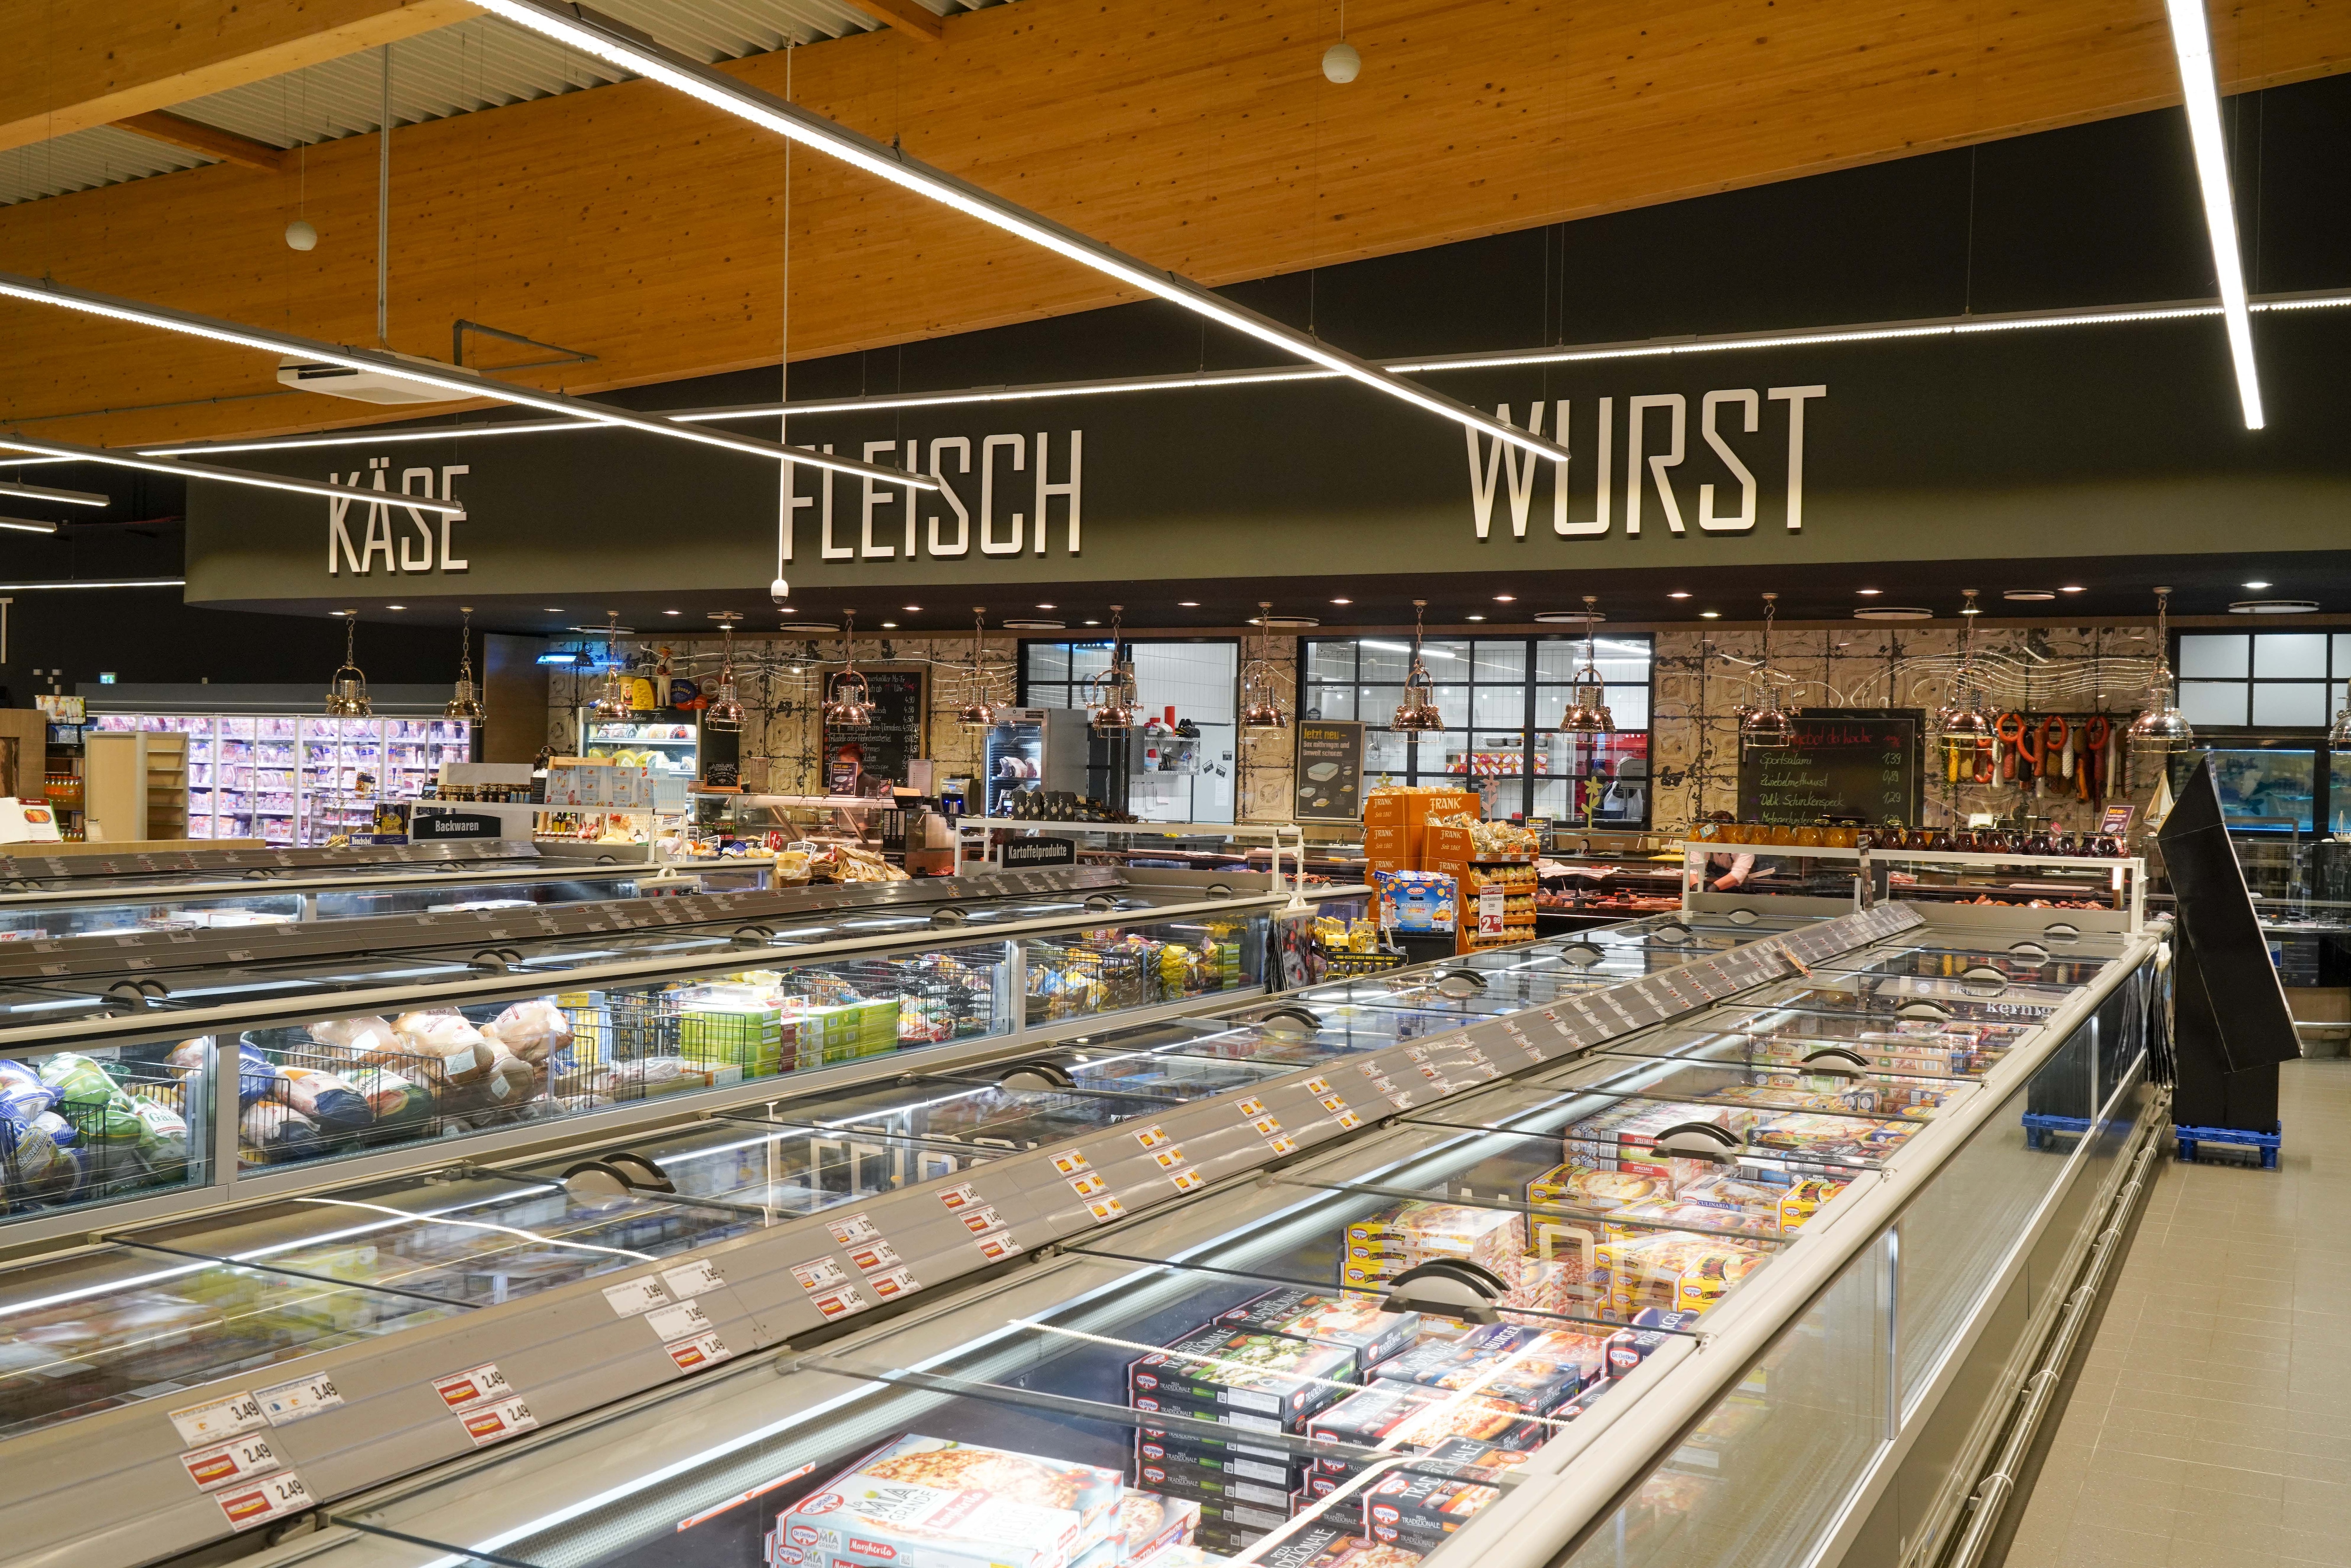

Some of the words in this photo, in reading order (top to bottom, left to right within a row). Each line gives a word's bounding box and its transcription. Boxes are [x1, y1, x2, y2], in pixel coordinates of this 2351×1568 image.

[1465, 385, 1826, 537] WURST
[783, 430, 1081, 559] FLEISCH
[329, 457, 469, 573] KÄSE
[1303, 728, 1322, 740] Jetzt
[1313, 741, 1339, 749] mitbringen
[1760, 752, 1812, 769] Sportsalami
[1373, 798, 1393, 808] FRANK
[1429, 796, 1462, 811] FRANK
[435, 820, 479, 832] Backwaren
[1374, 829, 1393, 839] FRANK
[1440, 830, 1462, 840] FRANK
[1009, 843, 1067, 861] Kartoffelprodukte
[1374, 861, 1394, 870] FRANK
[1438, 861, 1460, 871] FRANK
[1950, 985, 1982, 997] Jetzt
[1986, 1001, 2051, 1018] kernig
[1698, 1200, 1729, 1209] CULINARIA
[481, 1371, 505, 1389] 2.49
[311, 1382, 338, 1400] 3.49
[1160, 1383, 1191, 1393] TRADIZIONALE
[231, 1402, 259, 1420] 3.49
[507, 1404, 531, 1422] 2.49
[1160, 1407, 1192, 1417] TRADIZIONALE
[244, 1443, 272, 1463] 2.49
[1166, 1453, 1198, 1463] TRADIZIONALE
[1167, 1477, 1199, 1487] TRADIZIONALE
[276, 1480, 305, 1500] 2.49
[889, 1490, 939, 1521] GRANDE
[1323, 1513, 1357, 1525] TRADIZIONALE
[1402, 1517, 1441, 1529] TRADIZIONALE
[1156, 1521, 1184, 1546] Flammkuchen
[818, 1542, 839, 1551] GRANDE
[1400, 1535, 1436, 1548] TRADIZIONALE
[850, 1540, 892, 1557] Margherita
